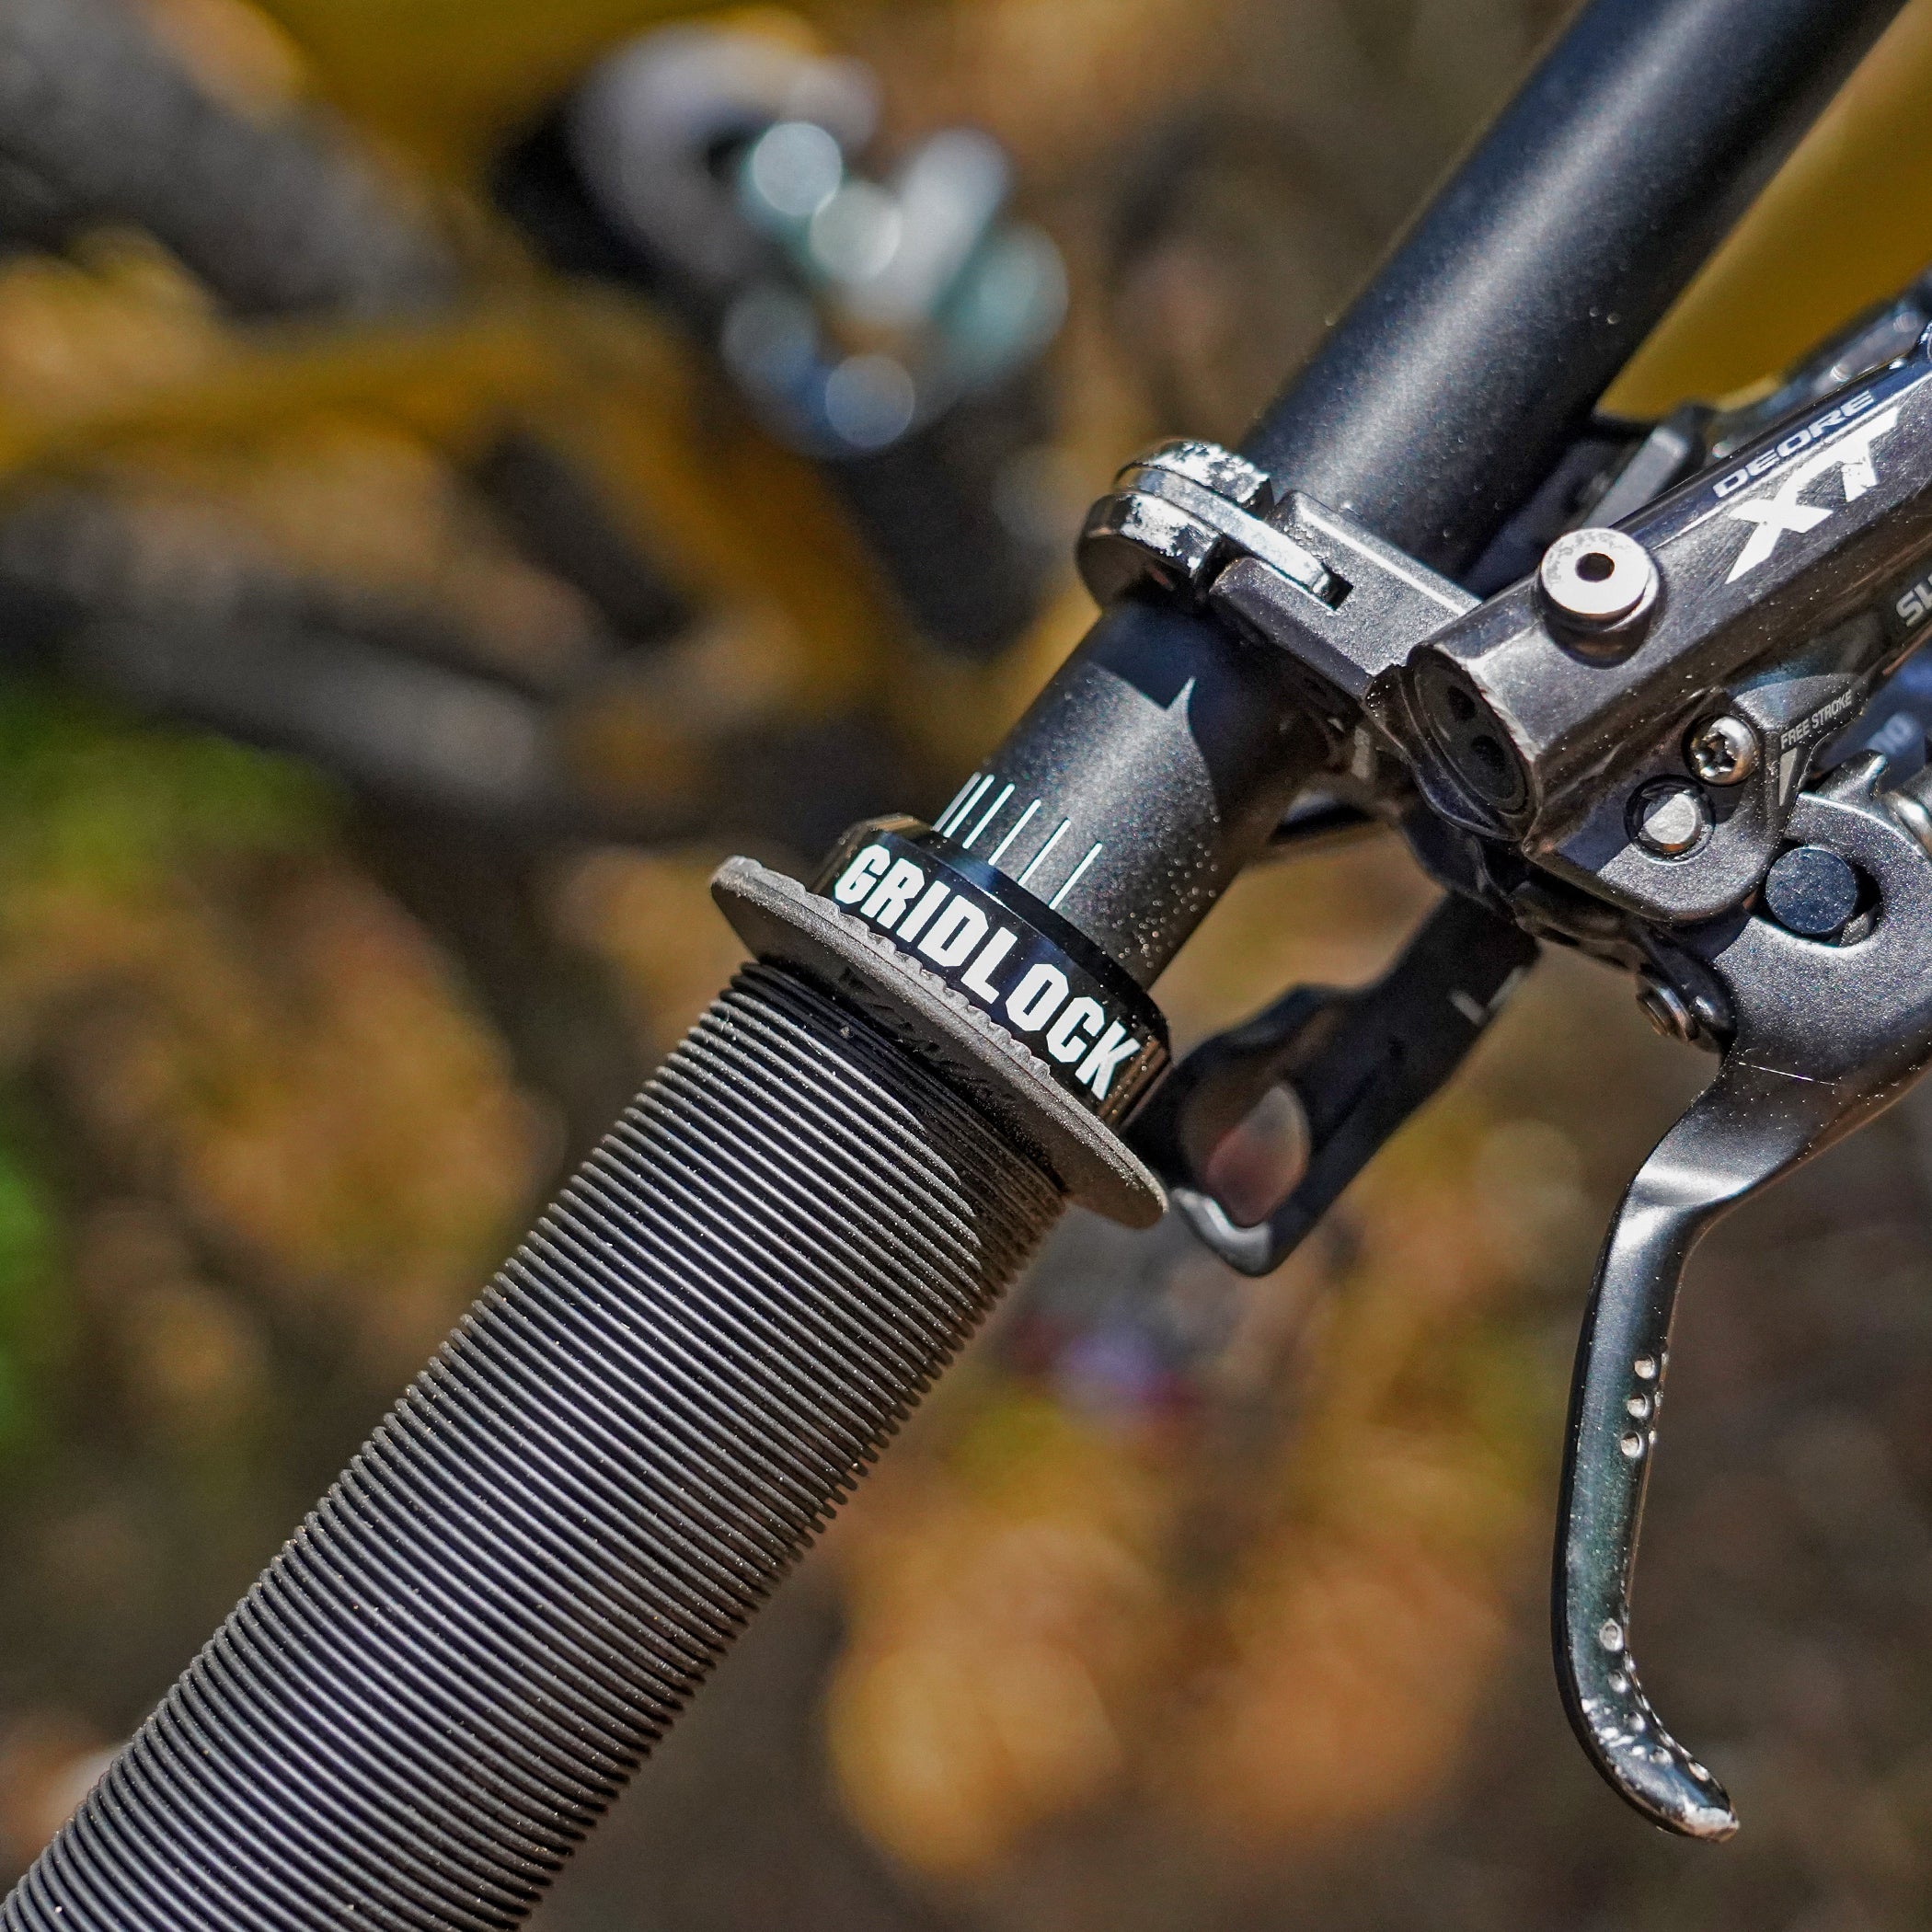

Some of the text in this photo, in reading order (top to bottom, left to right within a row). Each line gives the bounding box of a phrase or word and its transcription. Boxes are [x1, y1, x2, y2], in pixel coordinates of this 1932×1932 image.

[1712, 390, 1874, 498] DEORE
[1724, 406, 1901, 584] XT
[1780, 688, 1853, 750] FREE STROKE
[834, 844, 1141, 1101] GRIDLOCK
